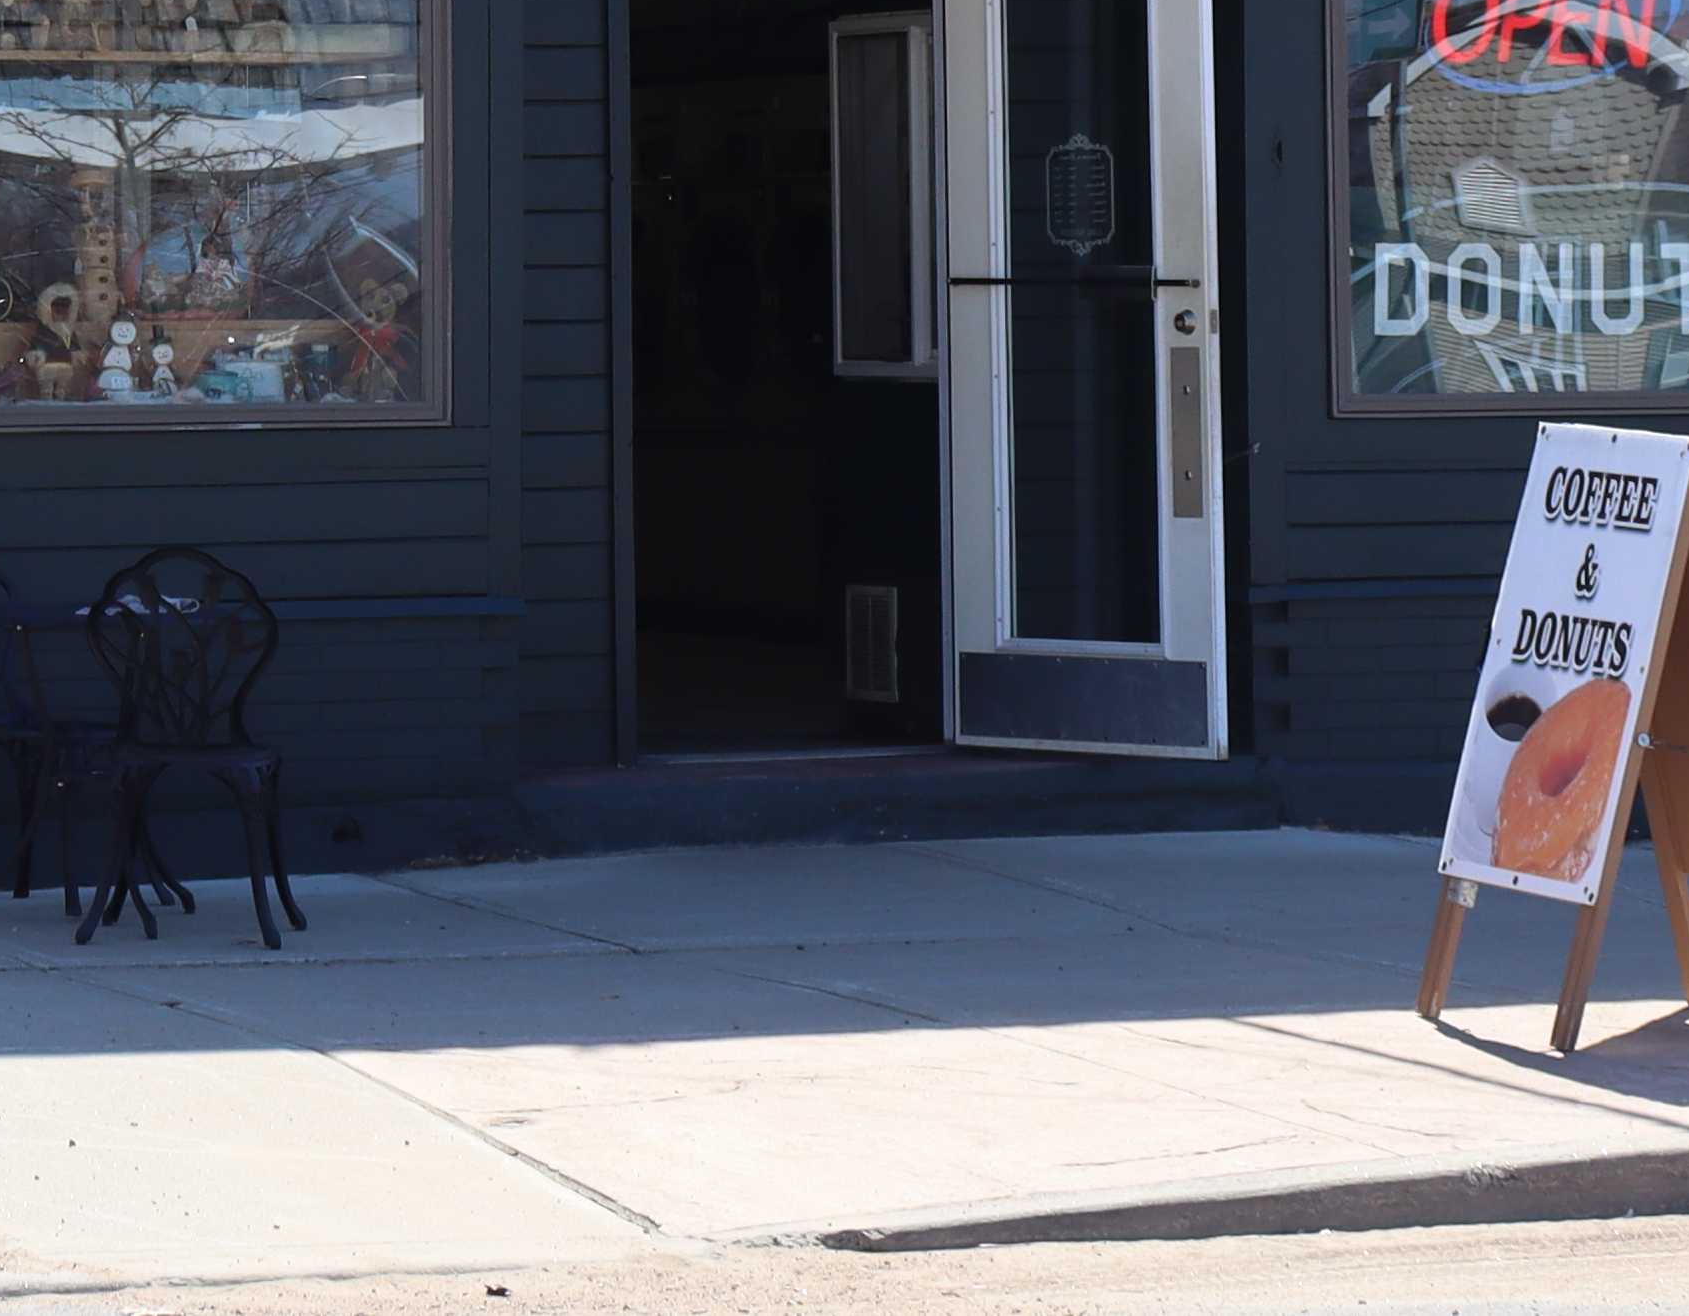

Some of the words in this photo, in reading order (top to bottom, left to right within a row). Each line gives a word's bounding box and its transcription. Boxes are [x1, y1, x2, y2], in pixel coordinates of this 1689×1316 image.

[1543, 465, 1660, 531] COFFEE
[1574, 543, 1599, 600] &
[1511, 608, 1634, 677] DONUTS
